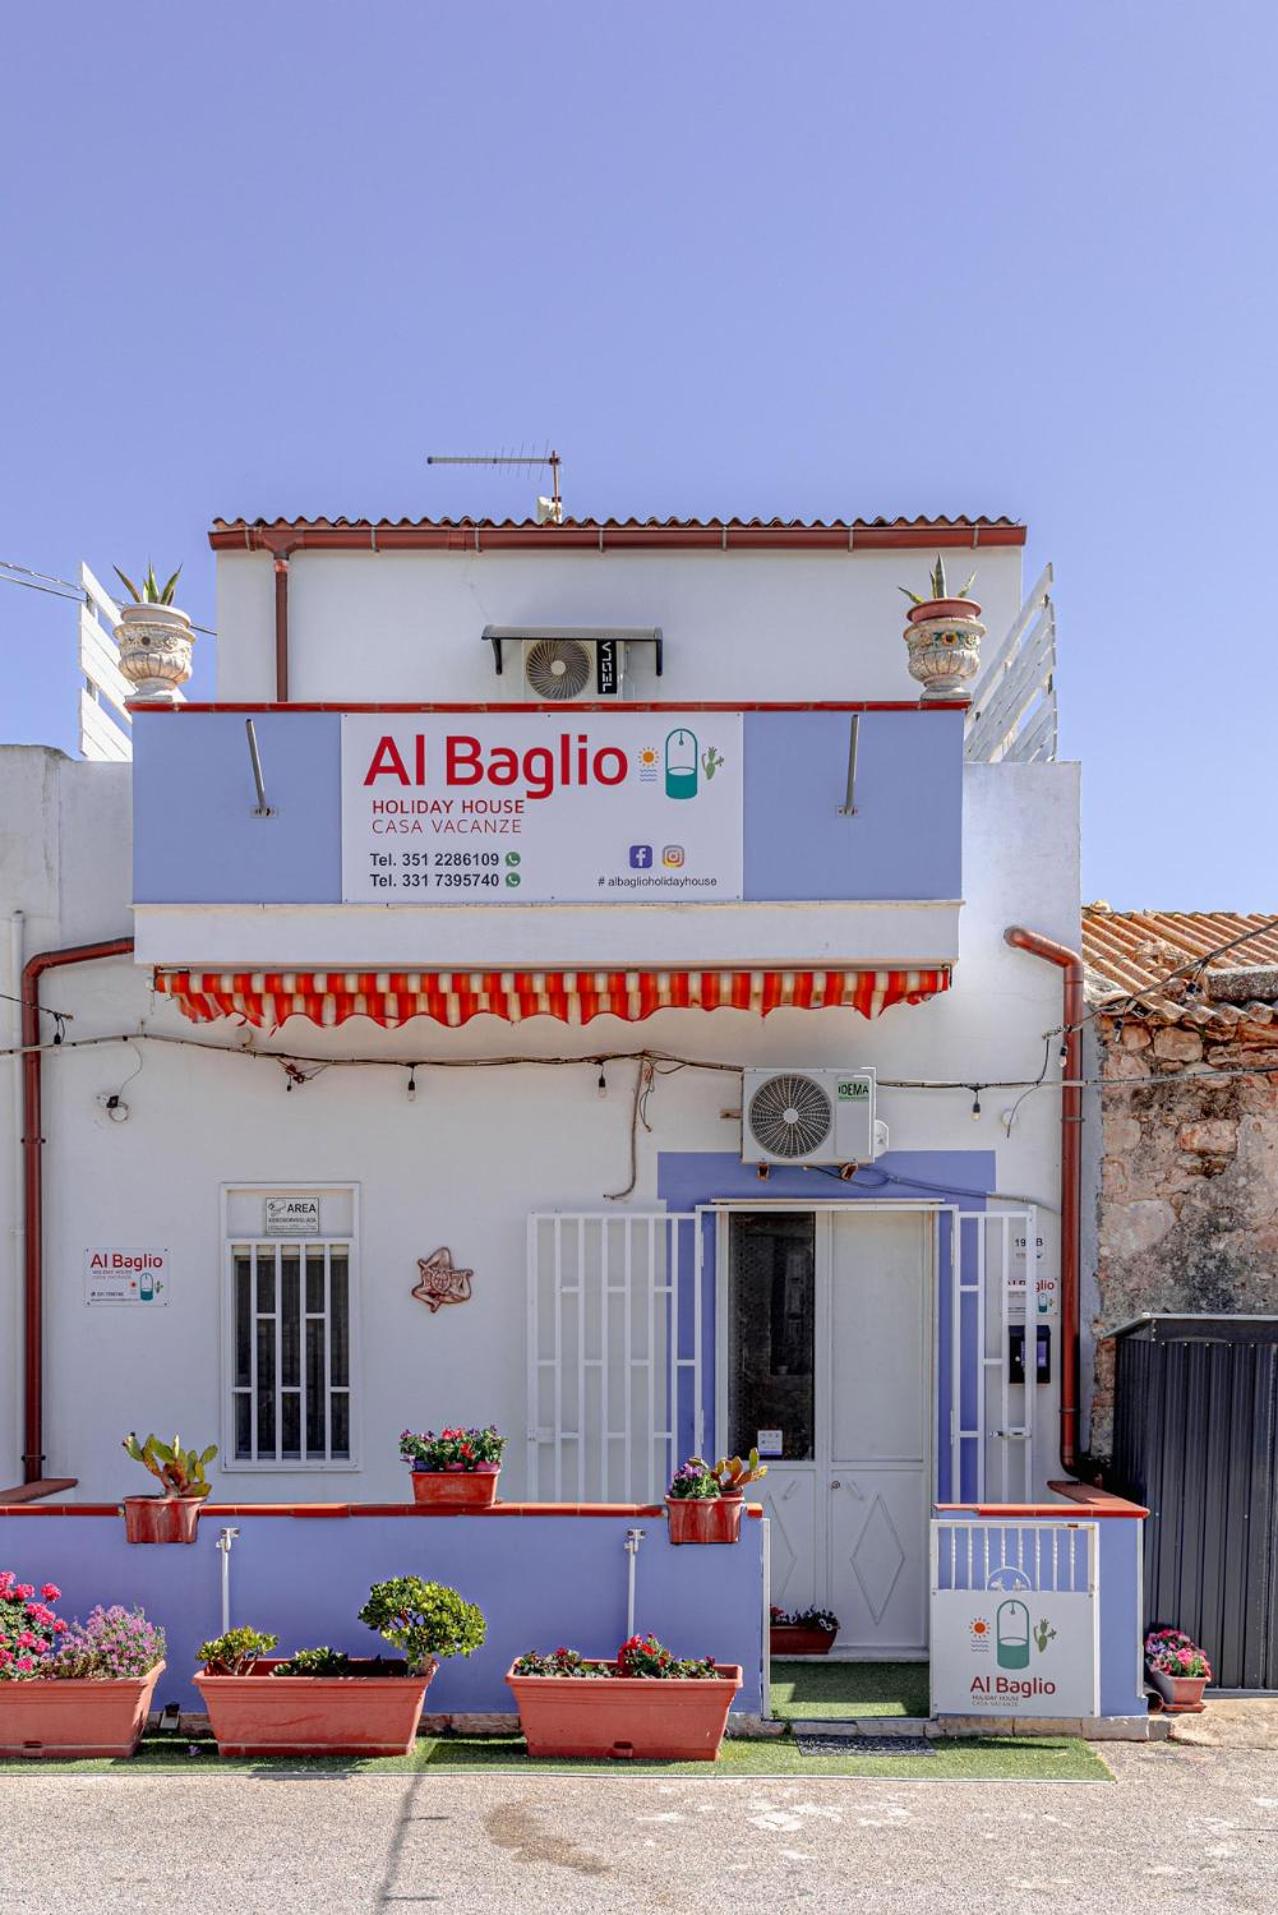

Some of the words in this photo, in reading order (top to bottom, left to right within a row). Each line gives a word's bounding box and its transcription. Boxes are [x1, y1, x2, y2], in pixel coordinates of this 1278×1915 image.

[602, 641, 612, 692] TESLA
[363, 734, 426, 786] Al
[446, 733, 629, 800] Baglio
[372, 799, 453, 814] HOLIDAY
[462, 799, 525, 814] HOUSE
[372, 819, 423, 834] CASA
[431, 819, 522, 834] VACANZE
[370, 853, 397, 867] Tel.
[403, 853, 428, 867] 351
[434, 853, 500, 867] 2286109
[370, 873, 397, 887] Tel.
[403, 873, 428, 887] 331
[434, 873, 500, 887] 7395740
[608, 876, 717, 889] albaglioholidayhouse
[838, 1084, 869, 1096] IDEMA
[287, 1203, 316, 1213] AREA
[90, 1254, 108, 1268] Al
[112, 1254, 163, 1271] Baglio
[970, 1676, 990, 1693] Al
[996, 1677, 1056, 1698] Baglio
